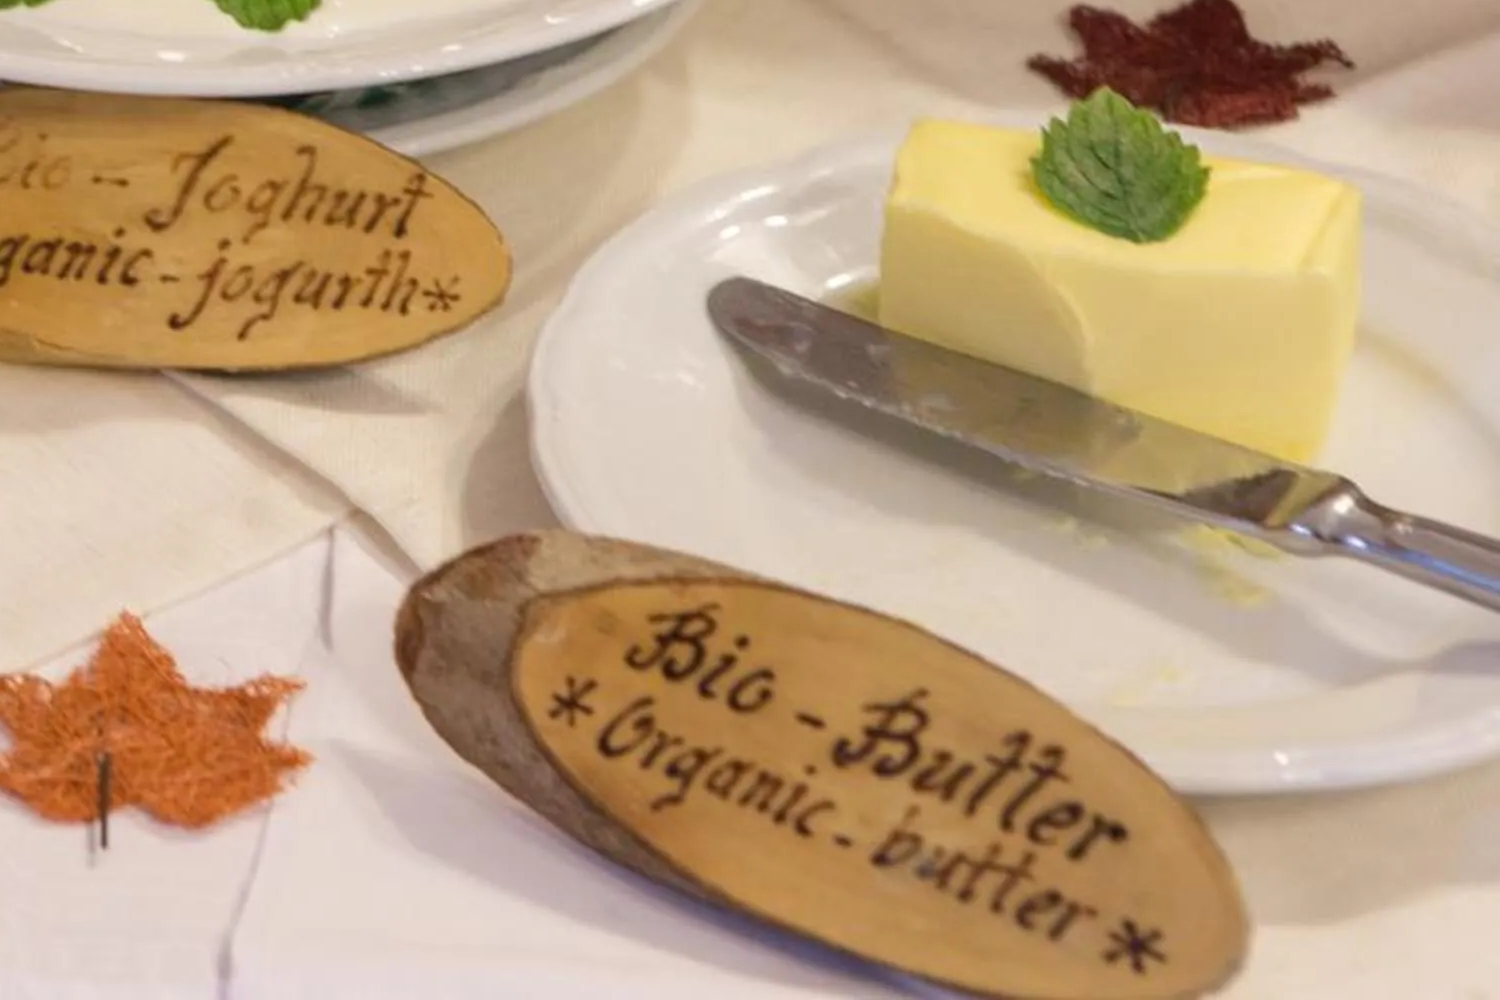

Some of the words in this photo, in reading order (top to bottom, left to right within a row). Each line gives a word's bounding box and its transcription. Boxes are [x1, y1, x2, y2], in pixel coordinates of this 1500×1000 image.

[144, 135, 435, 244] Joghurt
[622, 602, 776, 714] Bio
[831, 687, 1130, 862] Butter
